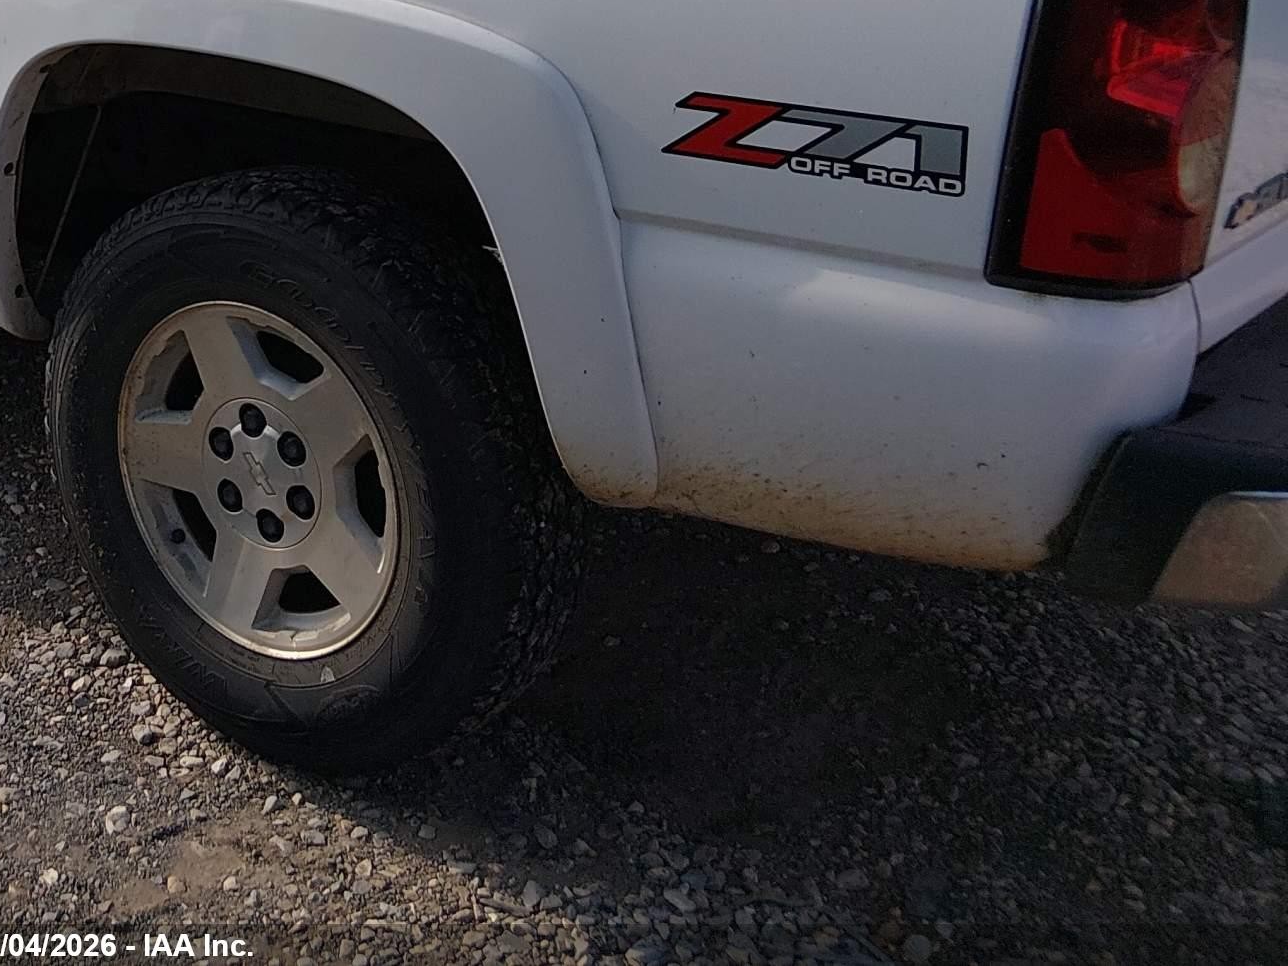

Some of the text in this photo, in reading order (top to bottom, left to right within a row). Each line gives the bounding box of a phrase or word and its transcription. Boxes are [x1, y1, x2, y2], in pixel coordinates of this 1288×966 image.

[661, 91, 969, 177] Z71
[790, 156, 963, 195] OFF ROAD
